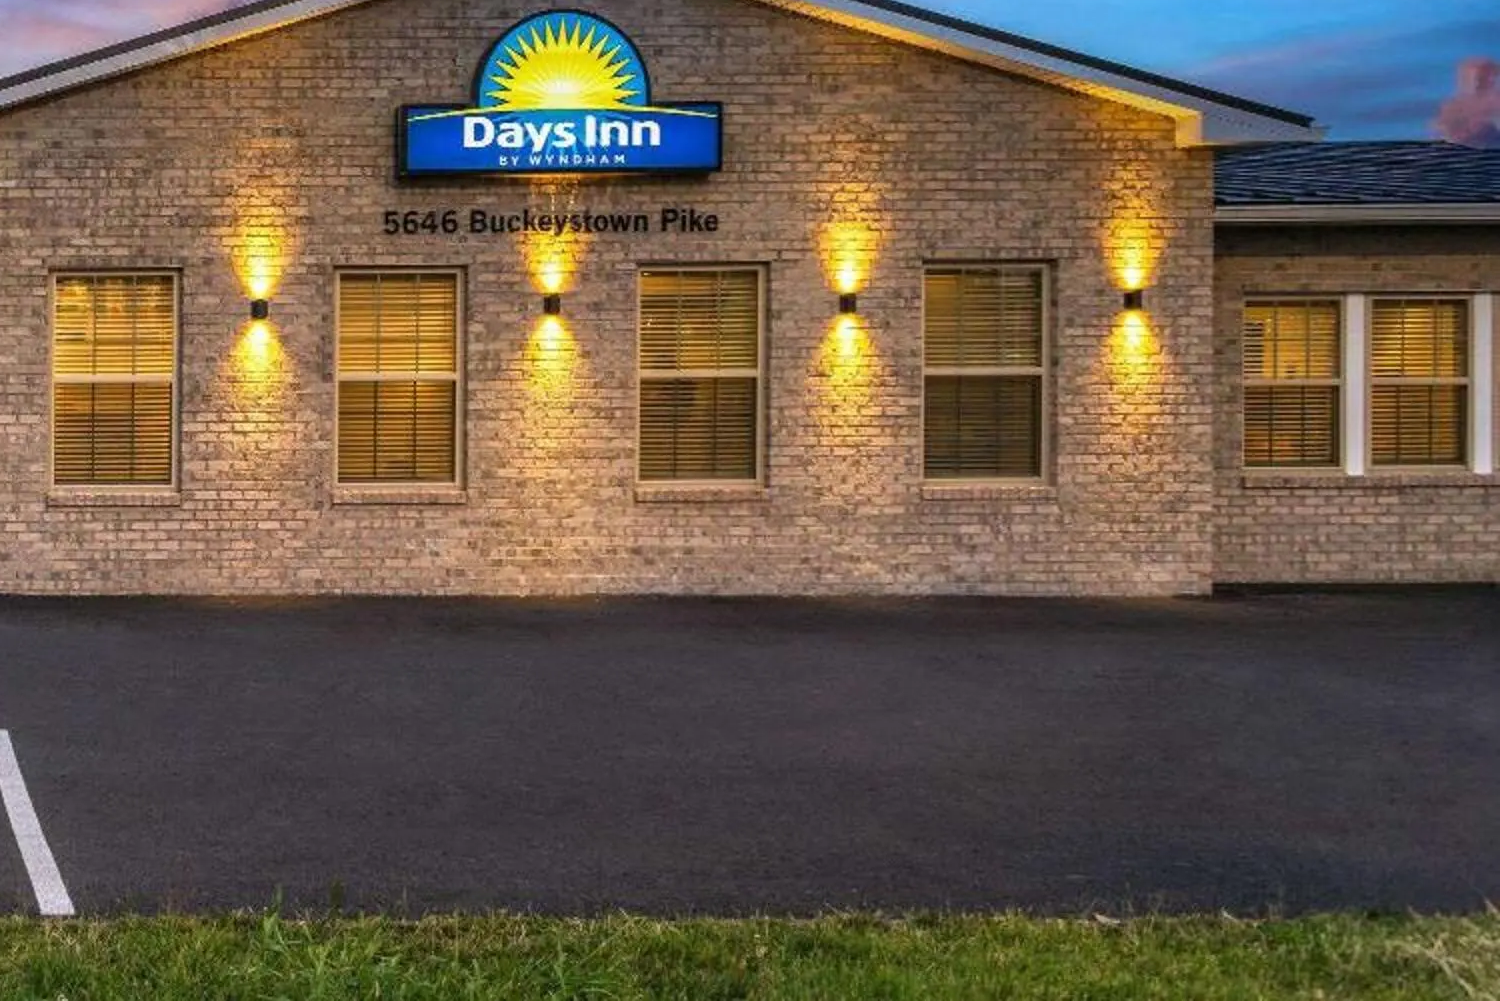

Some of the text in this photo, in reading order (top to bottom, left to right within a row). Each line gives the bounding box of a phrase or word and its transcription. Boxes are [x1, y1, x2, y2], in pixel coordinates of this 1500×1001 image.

[463, 116, 661, 151] Days Inn
[498, 153, 627, 167] BY WYNDHAM
[383, 209, 718, 236] 5646 Buckeystown Pike
